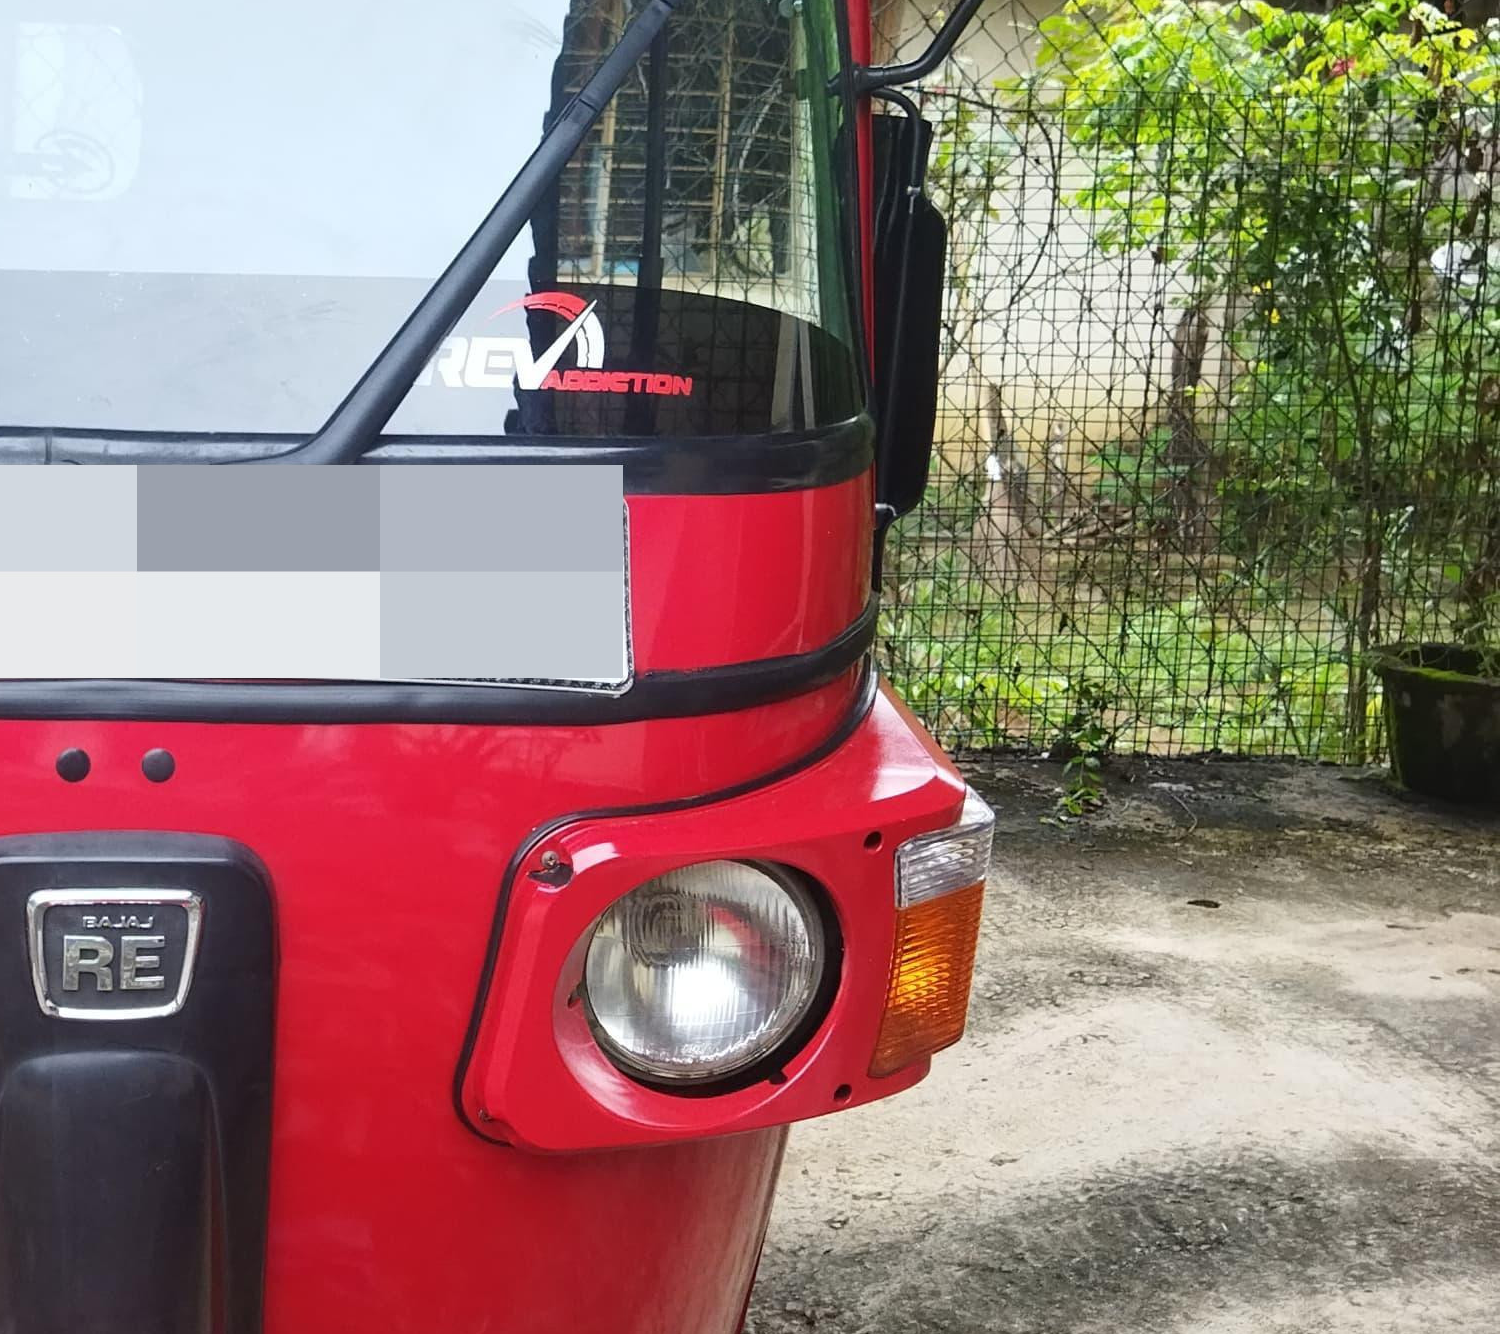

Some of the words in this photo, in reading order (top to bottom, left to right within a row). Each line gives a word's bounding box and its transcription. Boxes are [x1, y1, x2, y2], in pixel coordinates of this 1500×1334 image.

[540, 371, 692, 396] ADDICTION
[82, 916, 154, 929] BAJAJ
[62, 934, 165, 992] RE
